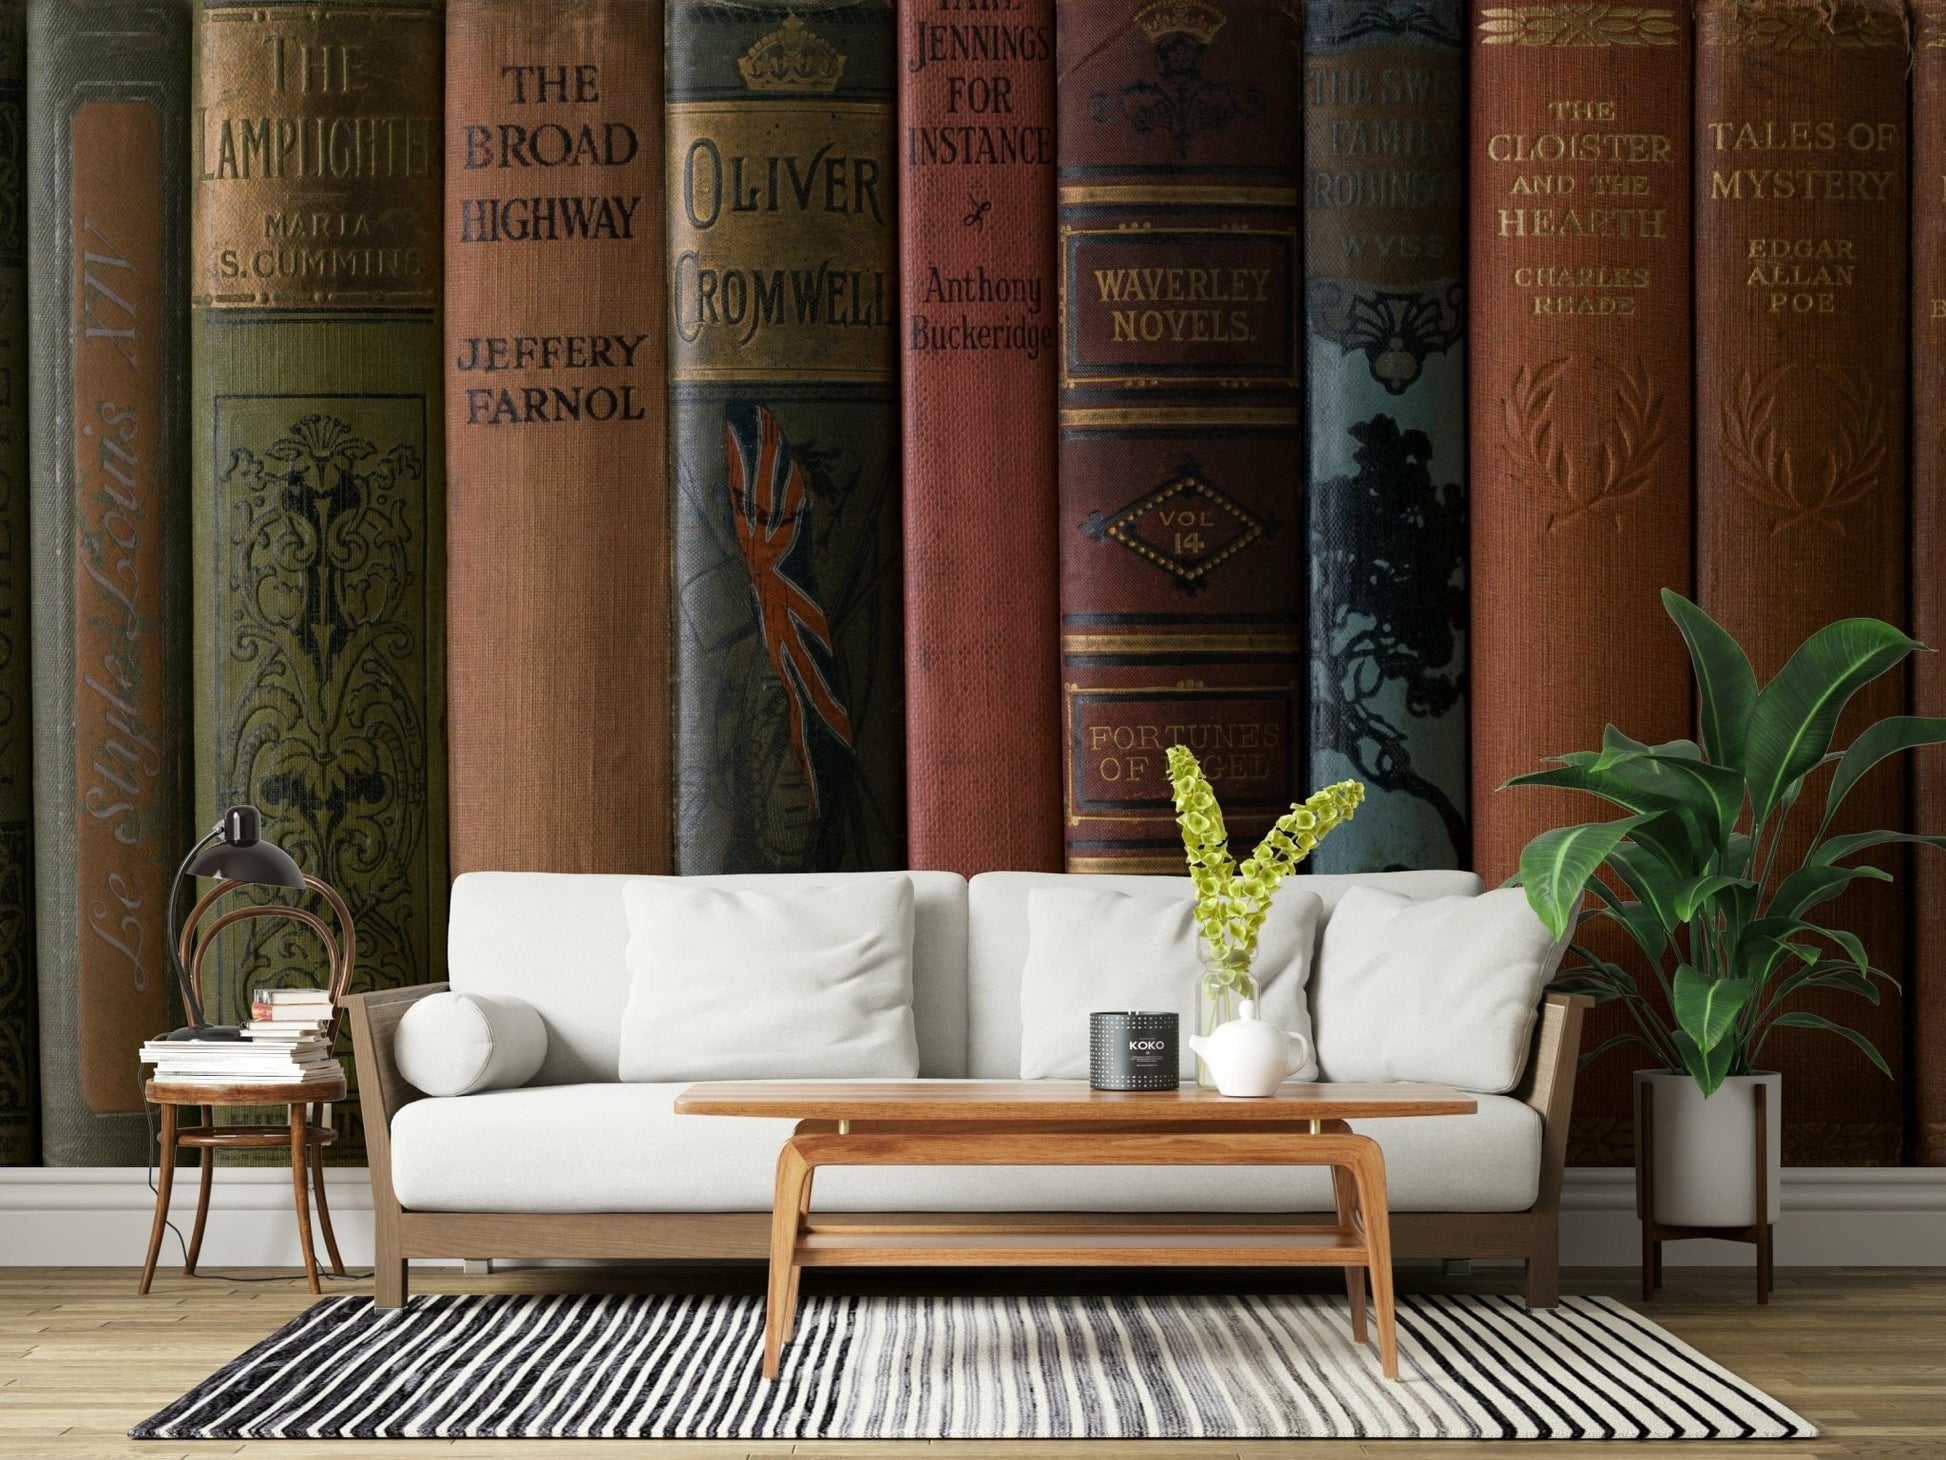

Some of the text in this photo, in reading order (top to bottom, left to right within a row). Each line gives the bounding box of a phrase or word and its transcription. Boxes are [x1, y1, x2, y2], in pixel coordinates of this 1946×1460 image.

[908, 21, 1051, 73] JENNINGS
[262, 35, 369, 95] THE
[502, 64, 601, 104] THE
[946, 76, 1013, 115] FOR
[1548, 100, 1616, 121] THE
[463, 123, 639, 169] BROAD
[908, 126, 1053, 167] INSTANCE
[1487, 132, 1675, 164] CLOISTER
[1708, 122, 1897, 151] TALES OF
[683, 137, 885, 230] OLIVER
[1509, 174, 1649, 195] AND THE
[1710, 169, 1895, 201] MYSTERY
[263, 211, 370, 238] MARIA
[460, 195, 641, 243] HIGHWAY
[1497, 208, 1667, 240] HEARTH
[1747, 238, 1857, 259] EDGAR
[923, 265, 1042, 314] Anthony
[1093, 268, 1272, 303] WAVERLEY
[1514, 267, 1650, 288] CHARLES
[1746, 265, 1856, 286] ALLAN
[673, 250, 895, 347] CROMWELL
[1532, 295, 1635, 316] READE
[1768, 292, 1835, 313] POE
[457, 333, 649, 373] JEFFERY
[909, 314, 1053, 360] Buckeridge
[466, 384, 646, 426] FARNOL
[1158, 511, 1215, 527] VOL
[1173, 532, 1206, 556] 14
[81, 216, 160, 992] Le Style Louis XIV
[1089, 723, 1280, 751] FORTUNES
[1100, 753, 1271, 782] OF GEL
[1129, 1040, 1165, 1050] KOKO
